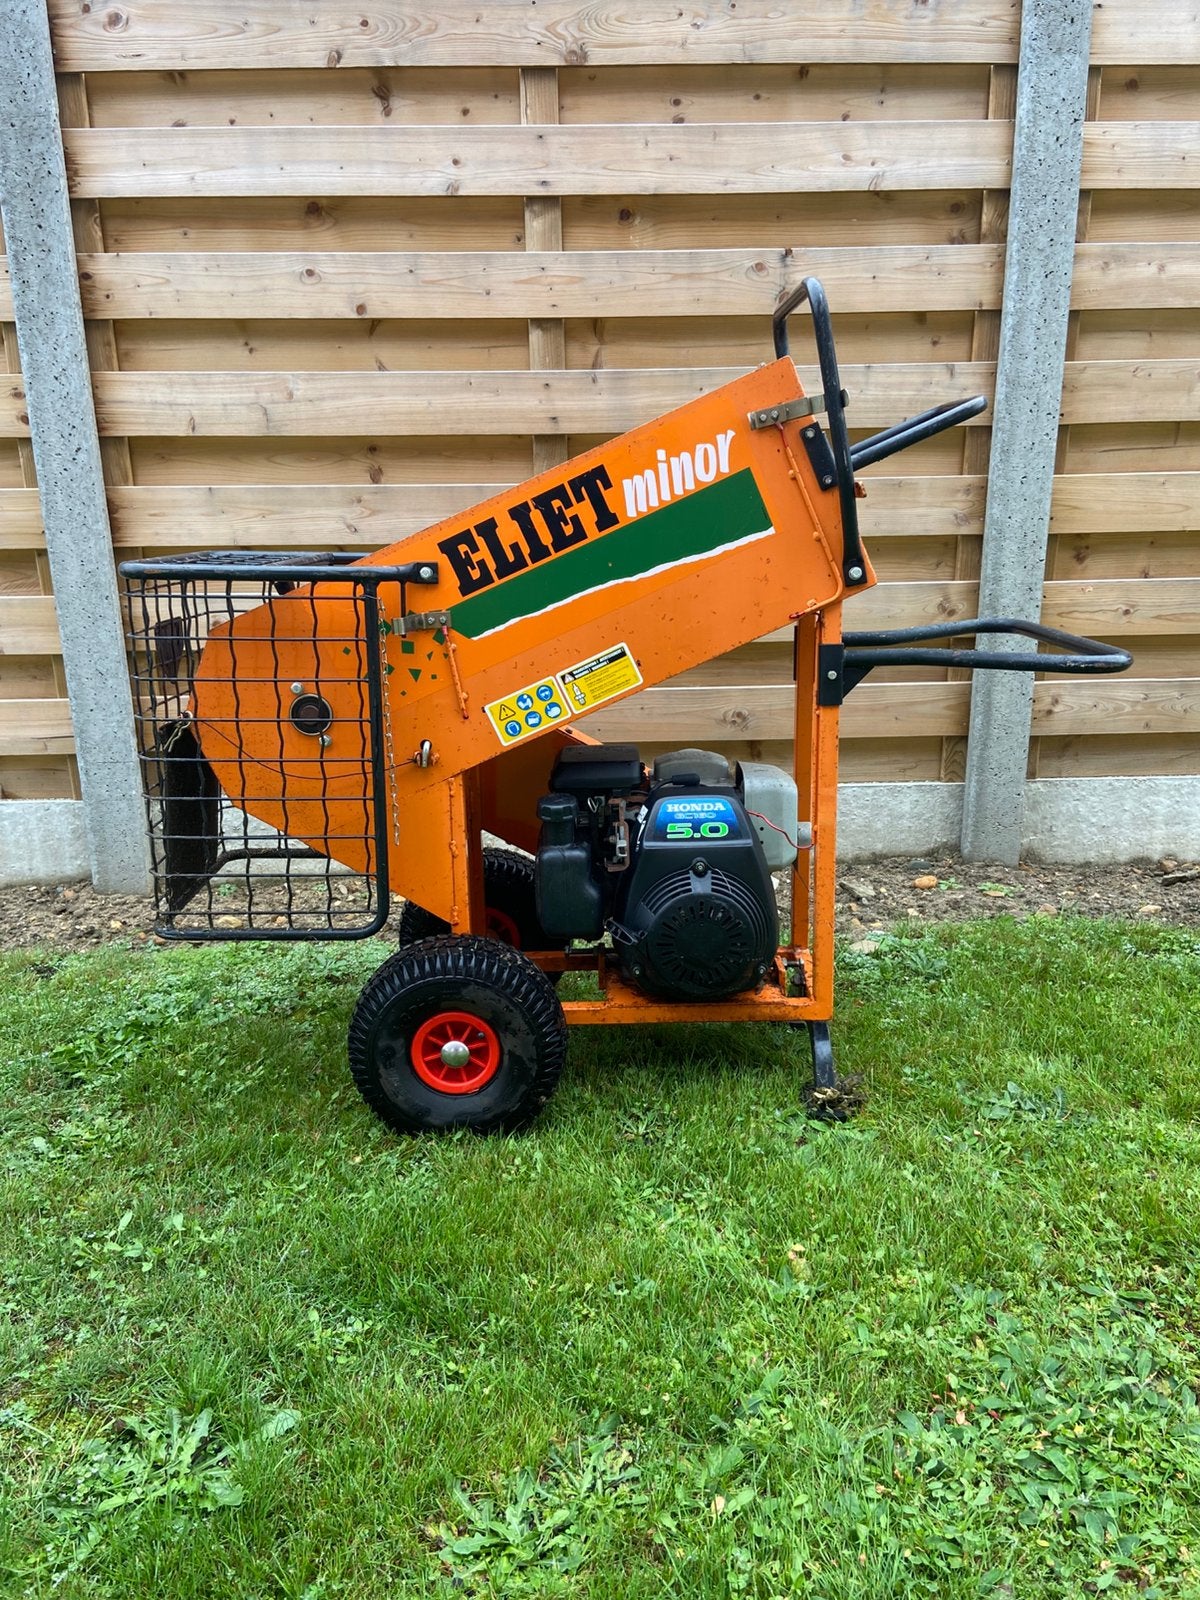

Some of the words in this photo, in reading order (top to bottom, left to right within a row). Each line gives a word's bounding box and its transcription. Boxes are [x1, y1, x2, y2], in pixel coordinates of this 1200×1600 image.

[437, 464, 620, 597] ELIET
[622, 429, 735, 517] minor
[666, 802, 726, 812] HONDA
[666, 822, 729, 839] 5.0
